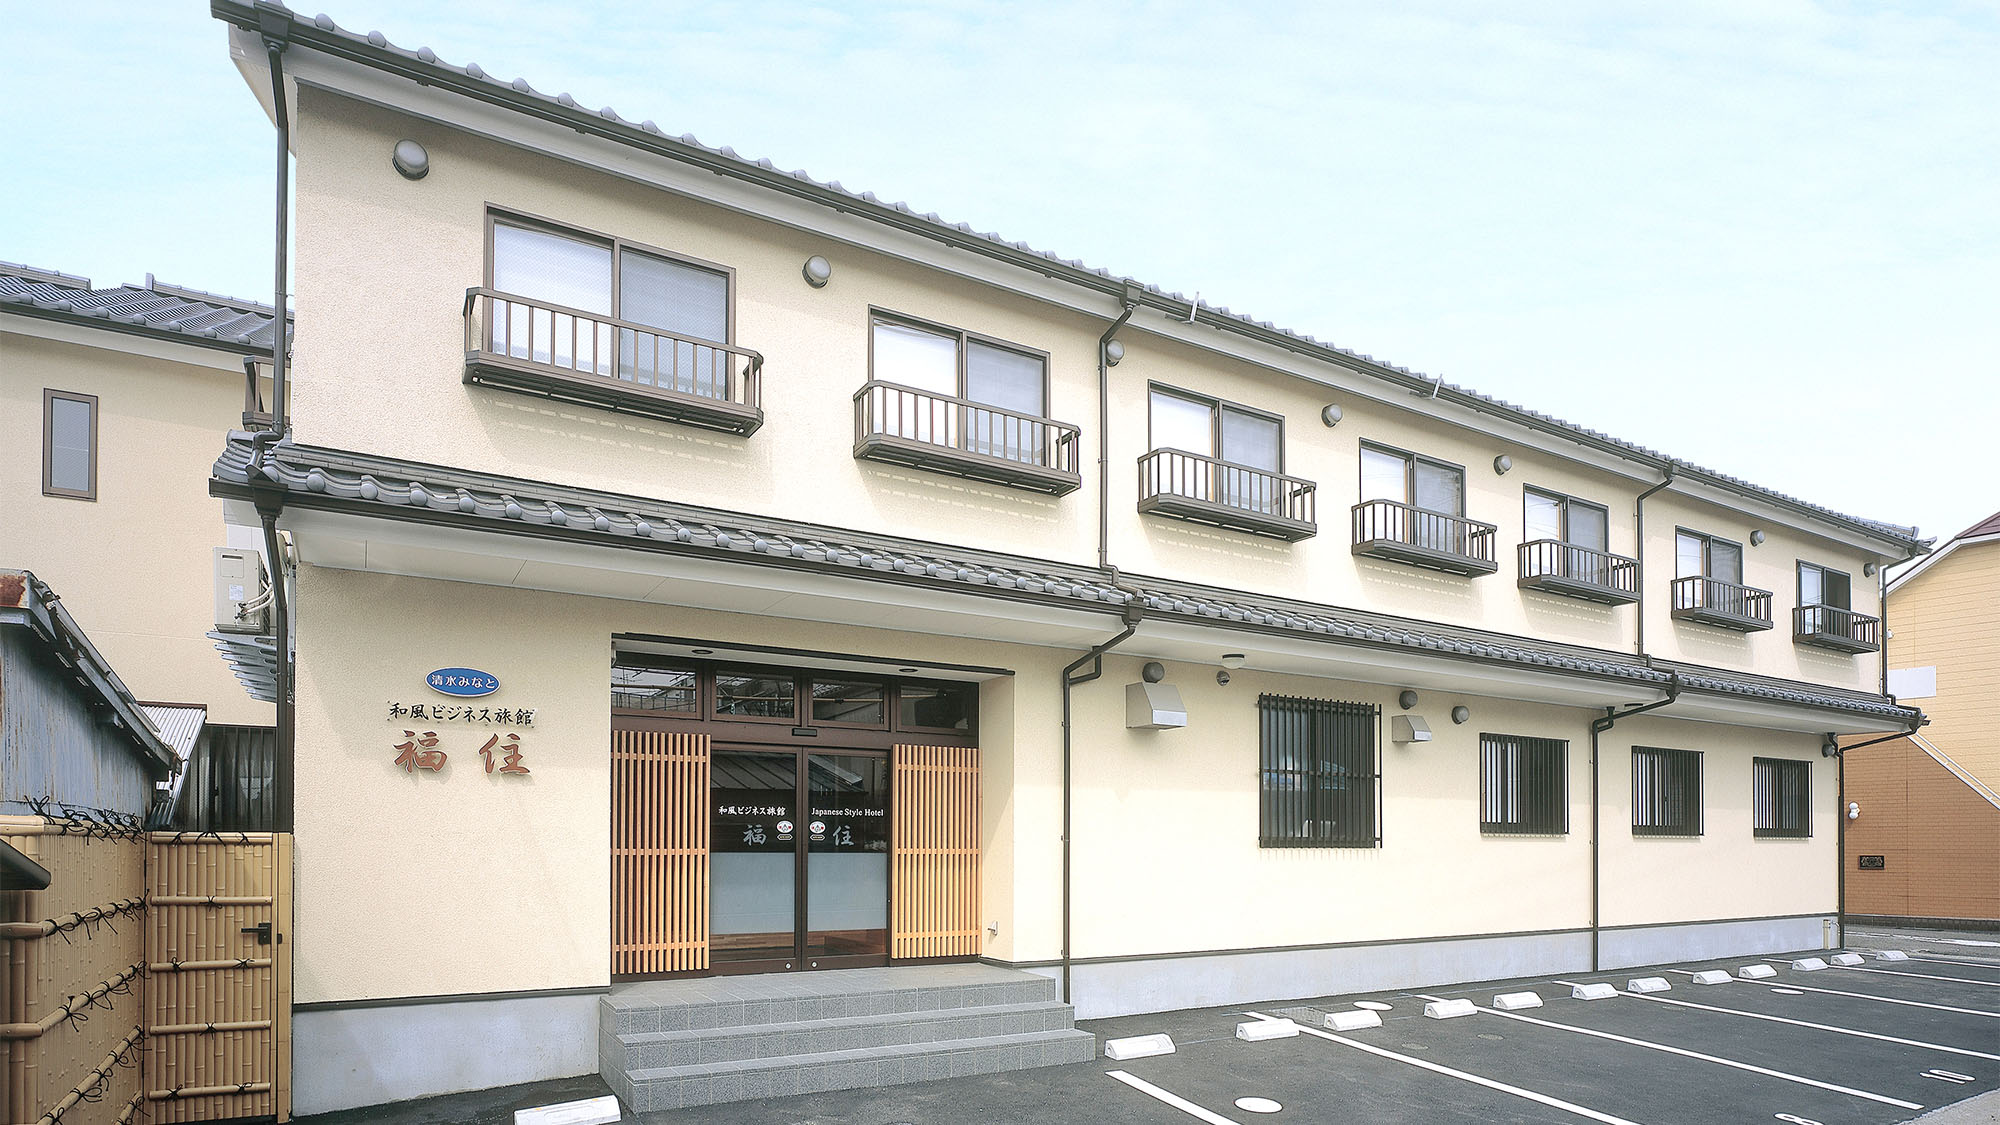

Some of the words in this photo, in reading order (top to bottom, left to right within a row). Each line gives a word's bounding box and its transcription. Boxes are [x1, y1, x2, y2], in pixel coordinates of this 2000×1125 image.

[431, 674, 496, 689] 清水みなと
[389, 702, 534, 726] 和風ビジネス旅館
[718, 805, 786, 816] 和風ビジネス旅館
[811, 807, 843, 817] Japanese
[844, 808, 863, 817] Style
[864, 808, 884, 817] Hotel
[743, 824, 767, 846] 福
[832, 825, 855, 846] 住
